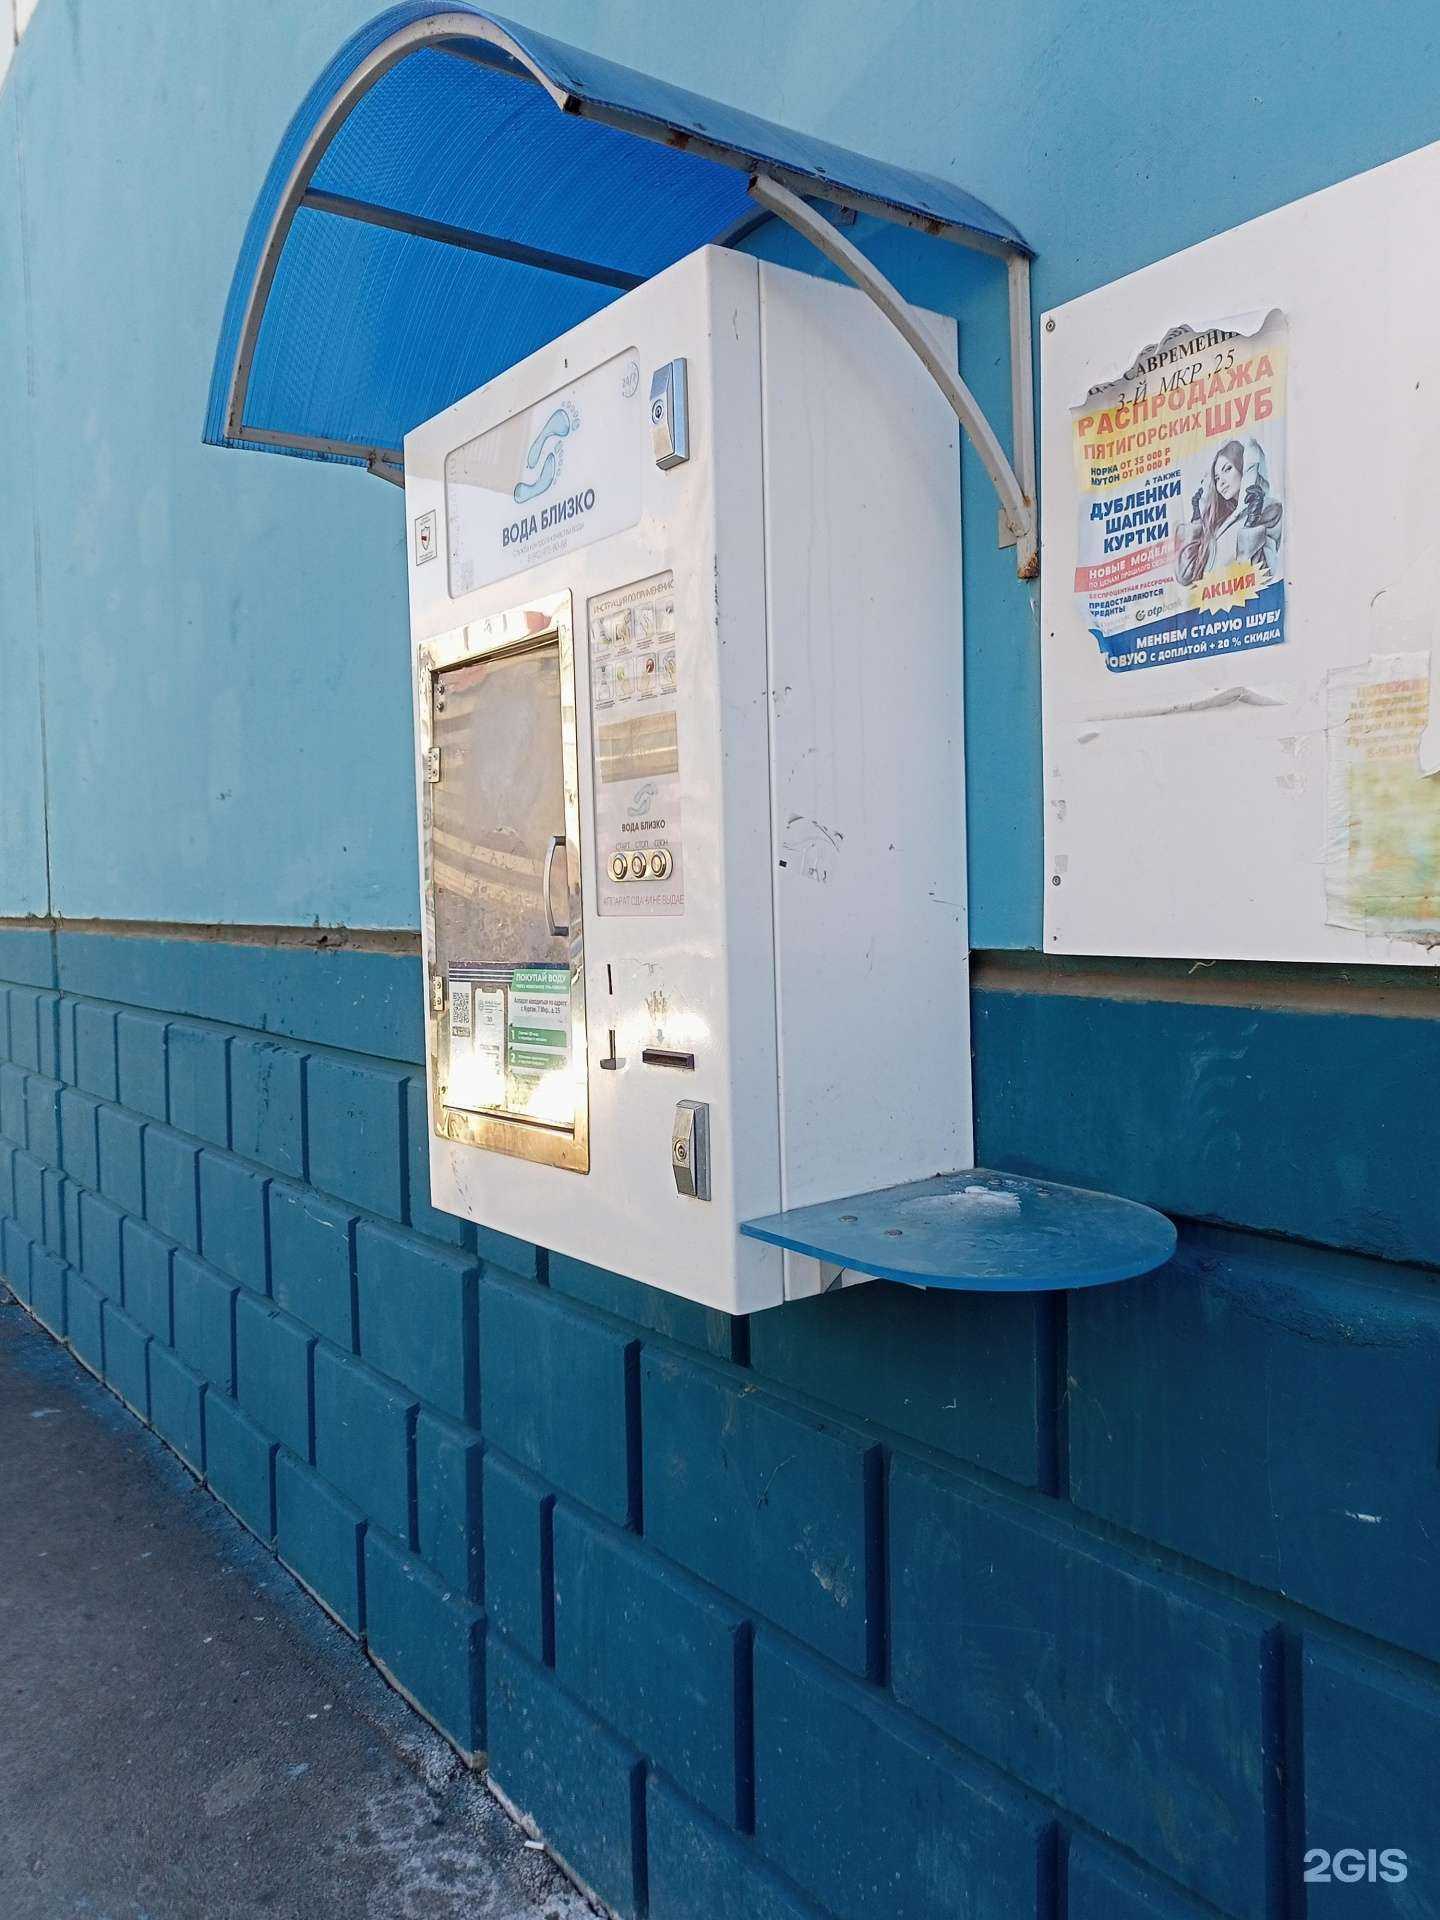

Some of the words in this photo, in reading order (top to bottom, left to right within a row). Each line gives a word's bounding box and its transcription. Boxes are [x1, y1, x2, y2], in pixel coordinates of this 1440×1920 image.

[1158, 361, 1202, 397] МКР
[1078, 354, 1274, 438] РАСПРОДАЖА
[1083, 411, 1202, 460] ПЯТИГОРСКИХ
[1205, 386, 1273, 437] ШУБ
[1090, 464, 1118, 476] НОРКА
[1120, 459, 1132, 470] ОТ
[1090, 473, 1120, 486] МУТОН
[1122, 469, 1133, 479] ОТ
[1136, 464, 1145, 475] 10
[1145, 479, 1151, 487] А
[1152, 469, 1181, 483] ТАКЖЕ
[1090, 479, 1182, 521] ДУБЛЕНКИ
[502, 514, 538, 547] ВОДА
[541, 488, 595, 531] БЛИЗКО
[1105, 503, 1167, 535] ШАПКИ
[1103, 521, 1169, 554] КУРТКИ
[1089, 560, 1126, 580] НОВЫЕ
[1130, 544, 1171, 567] МОДЕЛ
[1089, 588, 1164, 609] ПРЕДОСТАВЛЯЮТСЯ
[1202, 572, 1256, 600] АКЦИЯ
[1136, 628, 1188, 649] МЕНЯЕМ
[1191, 617, 1243, 638] СТАРУЮ
[1246, 608, 1281, 628] ШУБУ
[1158, 641, 1207, 661] ДОПЛАТОЙ
[1217, 638, 1230, 649] 20
[1232, 636, 1242, 647] %
[1244, 628, 1281, 644] СКИДКА
[621, 822, 640, 833] ВОДА
[641, 819, 666, 830] БЛИЗКО
